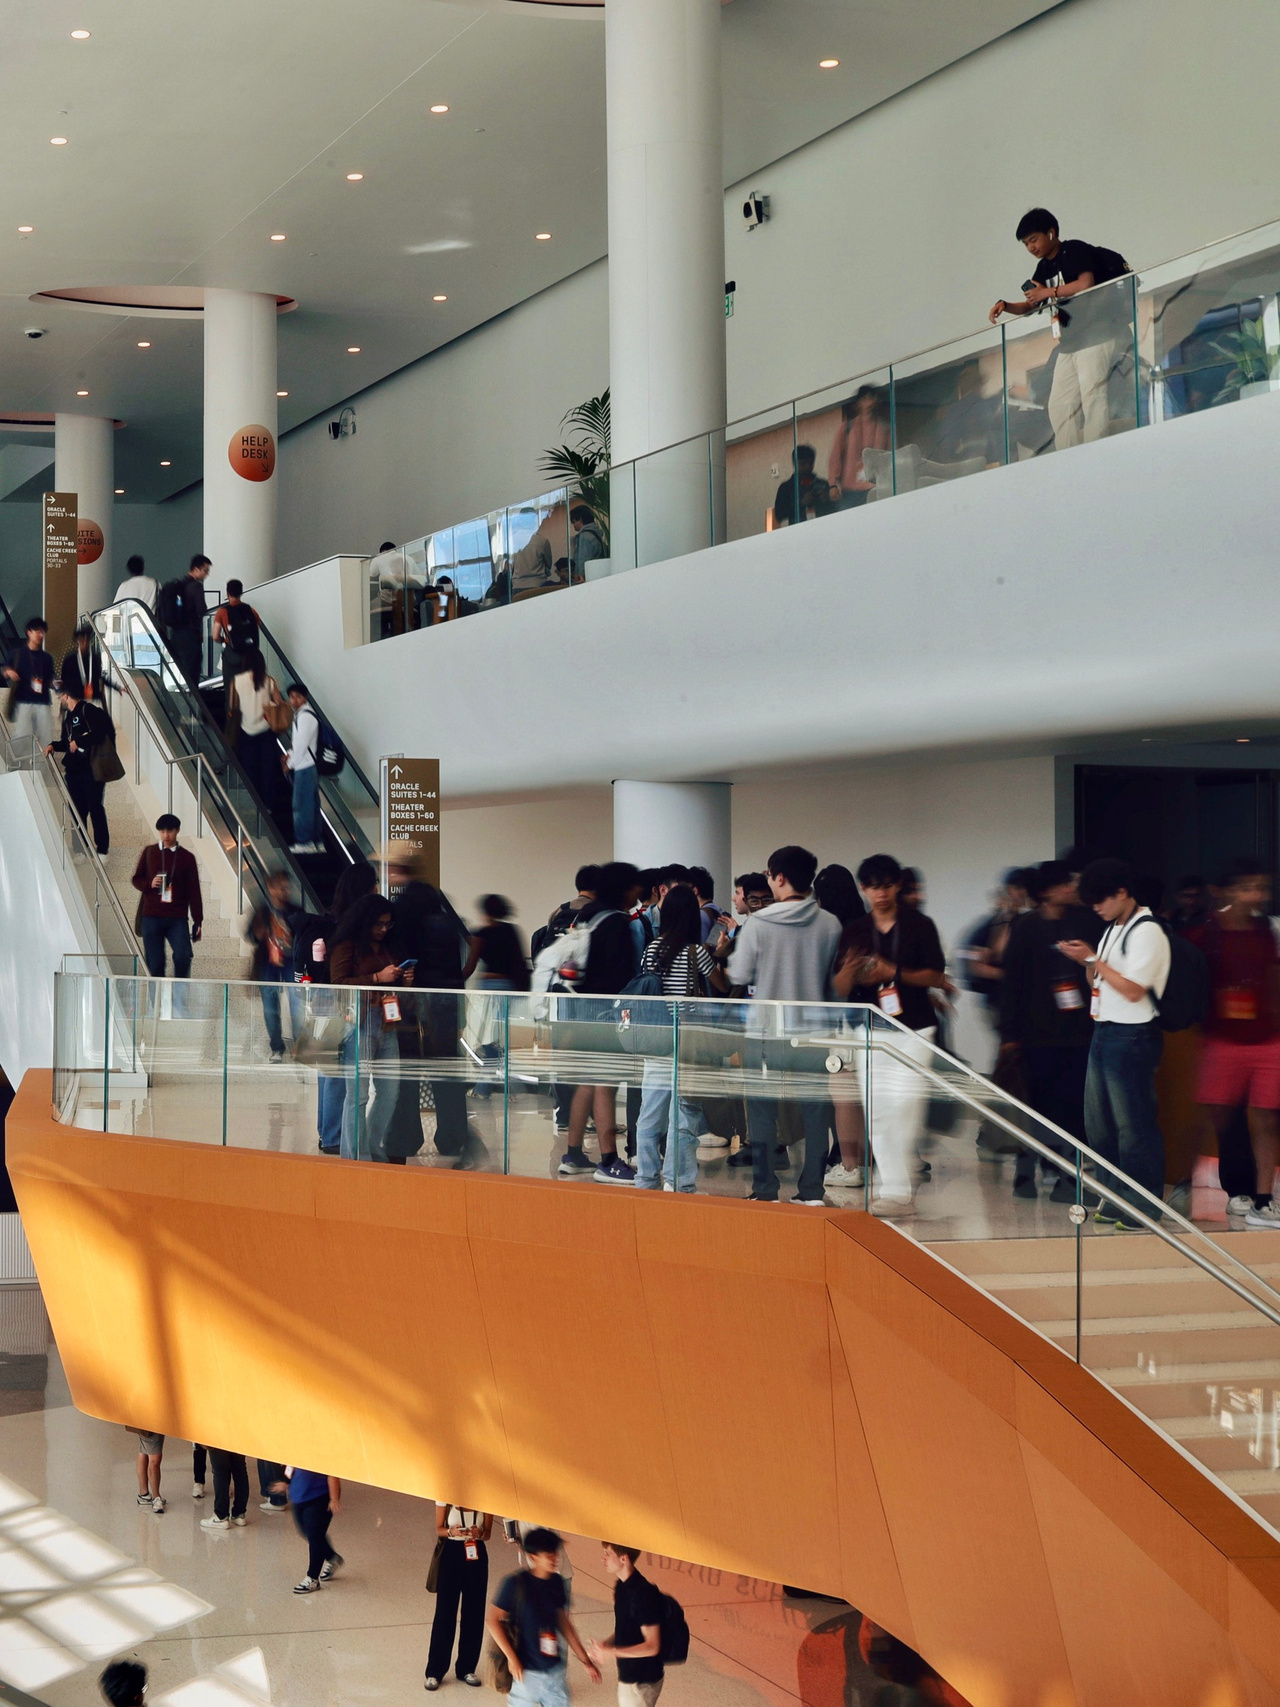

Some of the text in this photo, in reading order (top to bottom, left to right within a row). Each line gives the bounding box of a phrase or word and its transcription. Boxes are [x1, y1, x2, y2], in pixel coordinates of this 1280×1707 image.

[241, 436, 269, 447] HELP
[242, 448, 268, 459] DESK
[78, 538, 101, 546] SIONS
[390, 824, 439, 832] CACHE CREEK
